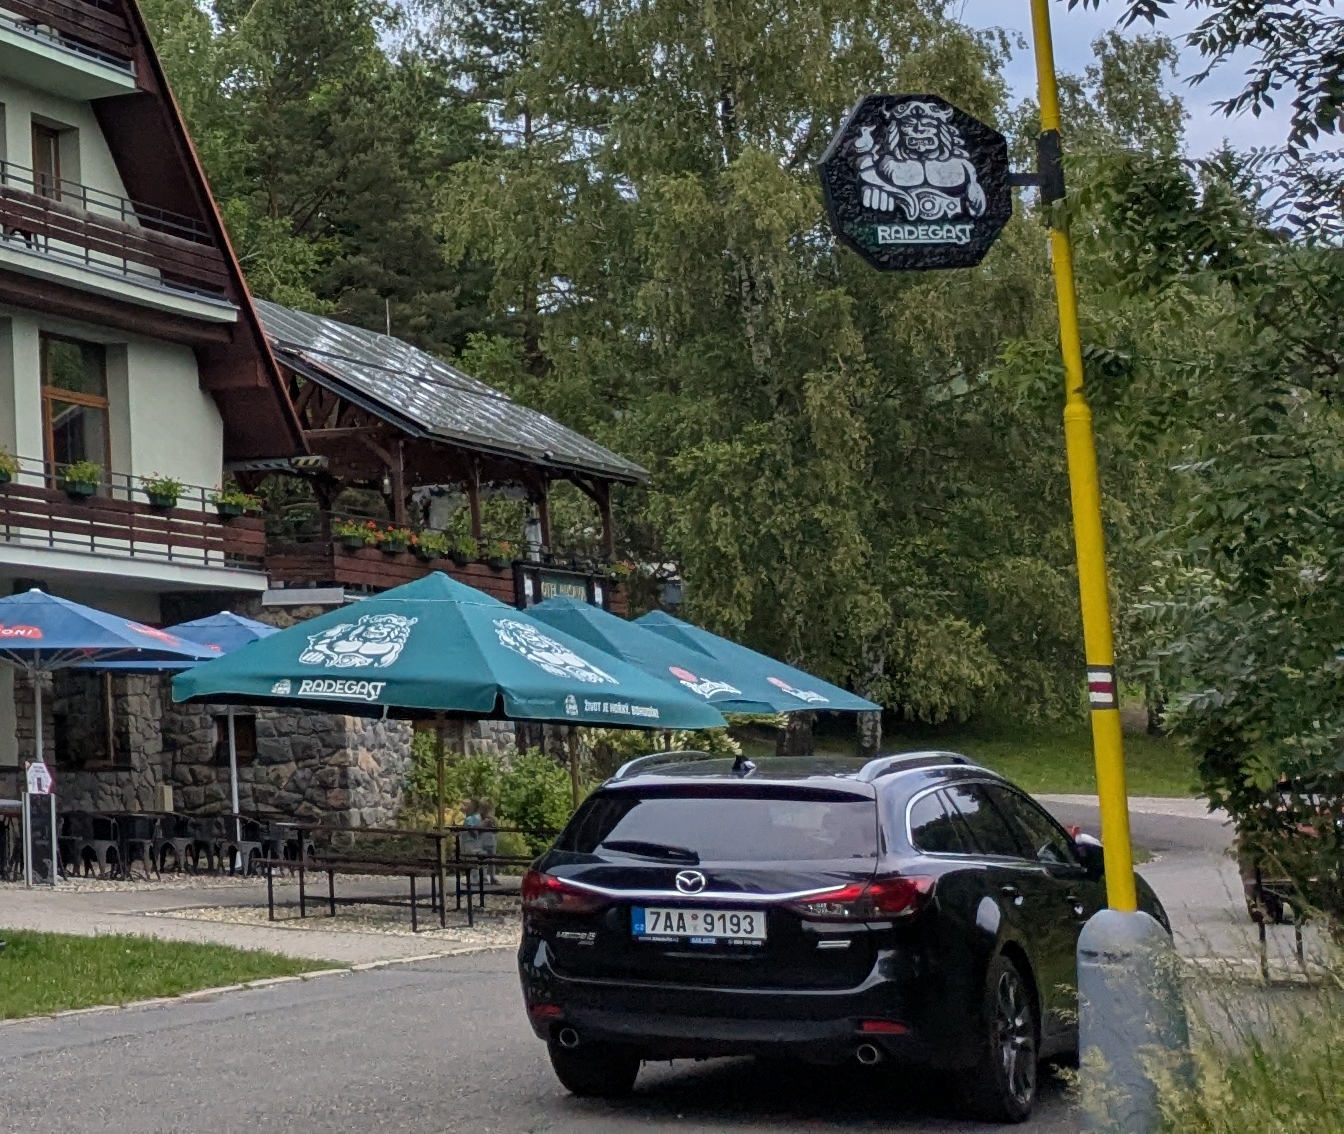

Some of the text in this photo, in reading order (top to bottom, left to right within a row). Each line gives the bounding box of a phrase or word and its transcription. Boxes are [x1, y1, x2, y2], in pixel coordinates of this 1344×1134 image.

[877, 224, 974, 244] RADEGAST
[298, 679, 386, 701] RADEGAST
[649, 911, 687, 933] 7AA
[703, 913, 755, 935] 9193
